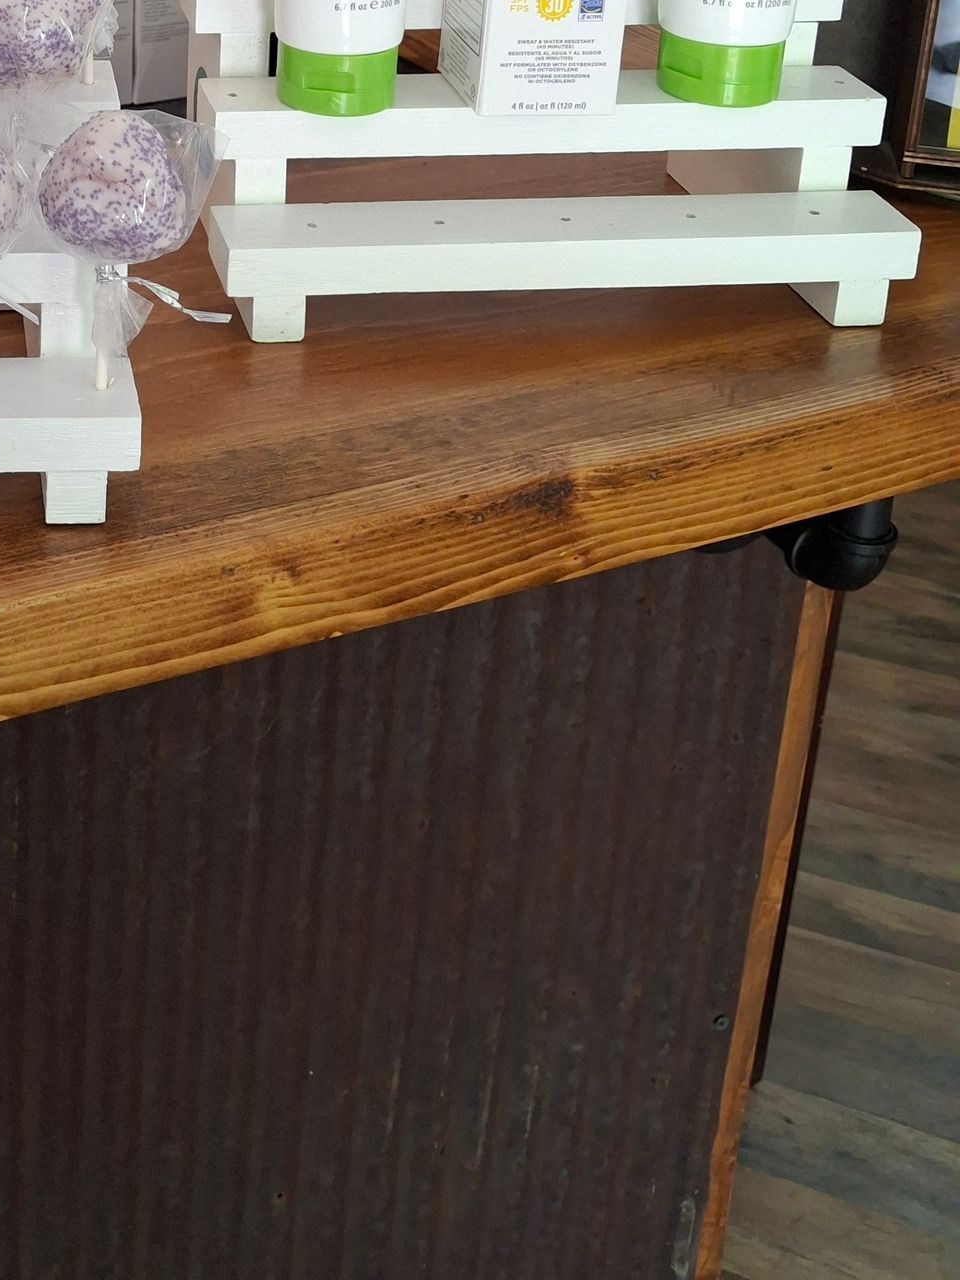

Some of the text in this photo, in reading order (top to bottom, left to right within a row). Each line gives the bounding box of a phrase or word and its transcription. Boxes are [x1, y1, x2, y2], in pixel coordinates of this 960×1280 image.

[350, 2, 356, 11] fl
[757, 0, 763, 8] fl
[509, 4, 530, 13] FPS
[518, 102, 524, 110] fl
[525, 102, 534, 110] oz
[539, 102, 549, 110] oz
[550, 102, 556, 110] fl
[557, 102, 572, 110] (120
[573, 102, 587, 110] ml)
